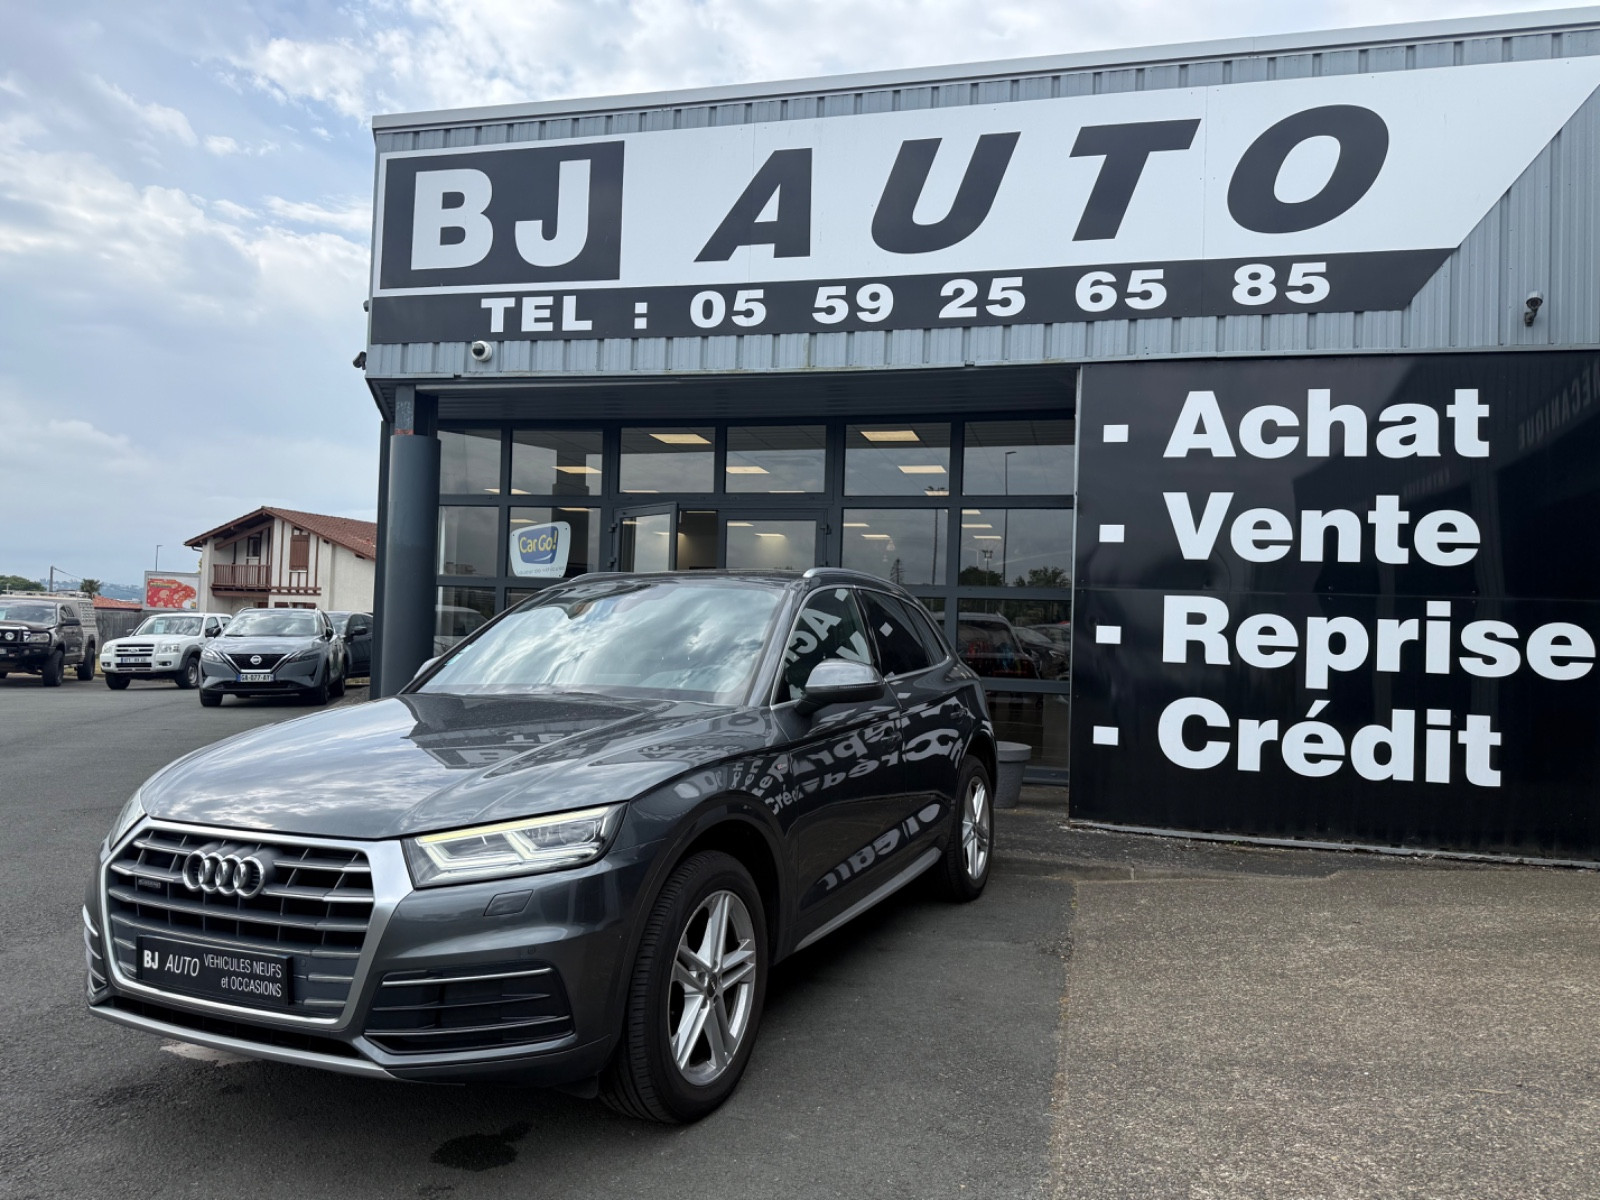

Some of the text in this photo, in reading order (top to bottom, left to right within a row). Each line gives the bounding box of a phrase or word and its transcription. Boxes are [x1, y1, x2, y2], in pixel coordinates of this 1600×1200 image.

[410, 104, 1389, 271] BJ AUTO
[480, 295, 593, 333] TEL
[689, 288, 767, 329] 05
[812, 283, 894, 325] 59
[938, 276, 1026, 319] 25
[1075, 268, 1168, 313] 65
[1231, 261, 1331, 306] 85
[1162, 388, 1490, 460] Achat
[1162, 491, 1481, 567] Vente
[1162, 594, 1596, 690] Reprise
[1157, 696, 1502, 787] Crédit
[143, 949, 200, 977] BJ AUTO
[203, 953, 282, 979] VEHICULES NEUFS
[220, 976, 282, 998] et OCCASIONS
